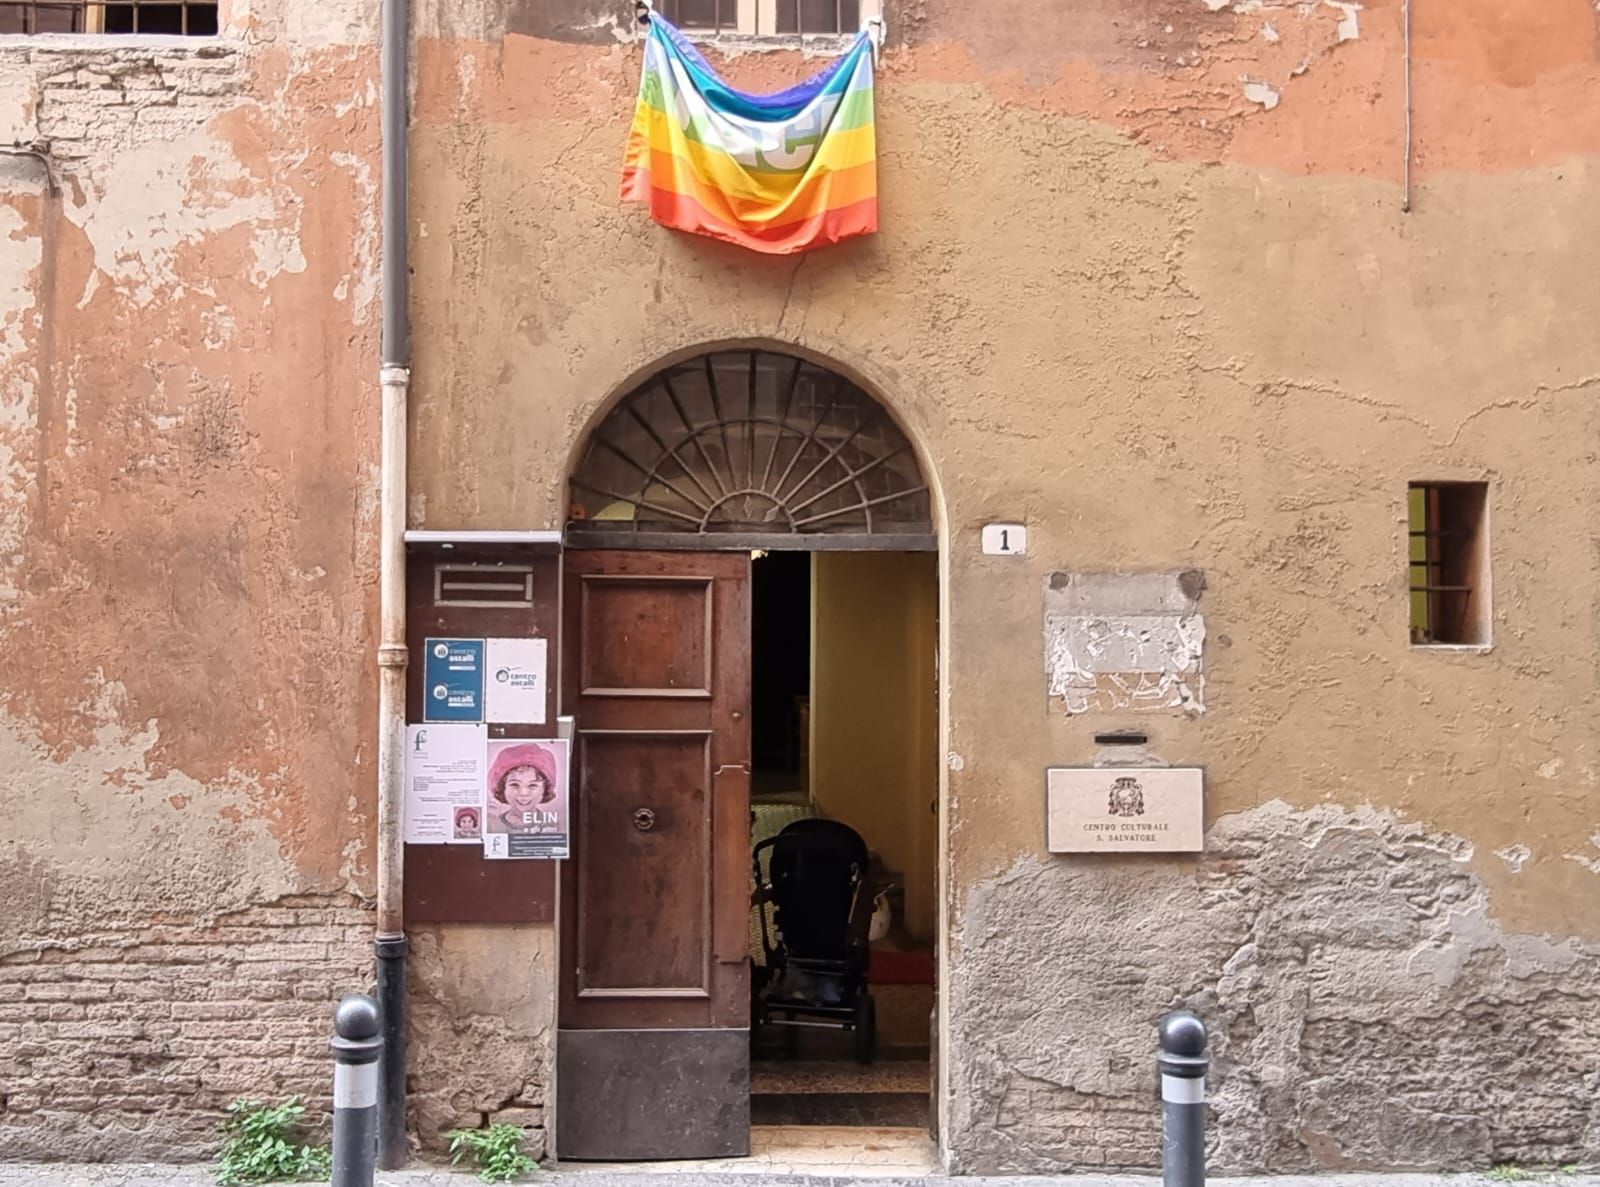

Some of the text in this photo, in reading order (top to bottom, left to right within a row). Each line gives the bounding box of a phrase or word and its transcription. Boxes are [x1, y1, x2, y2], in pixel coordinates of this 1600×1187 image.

[1000, 529, 1010, 551] 1
[449, 648, 477, 656] centro
[510, 673, 537, 681] centro
[448, 695, 474, 703] astalli
[523, 811, 558, 824] ELIN
[1083, 823, 1169, 831] CENTRO CULTURALE
[1096, 834, 1157, 842] S. SALVATORE
